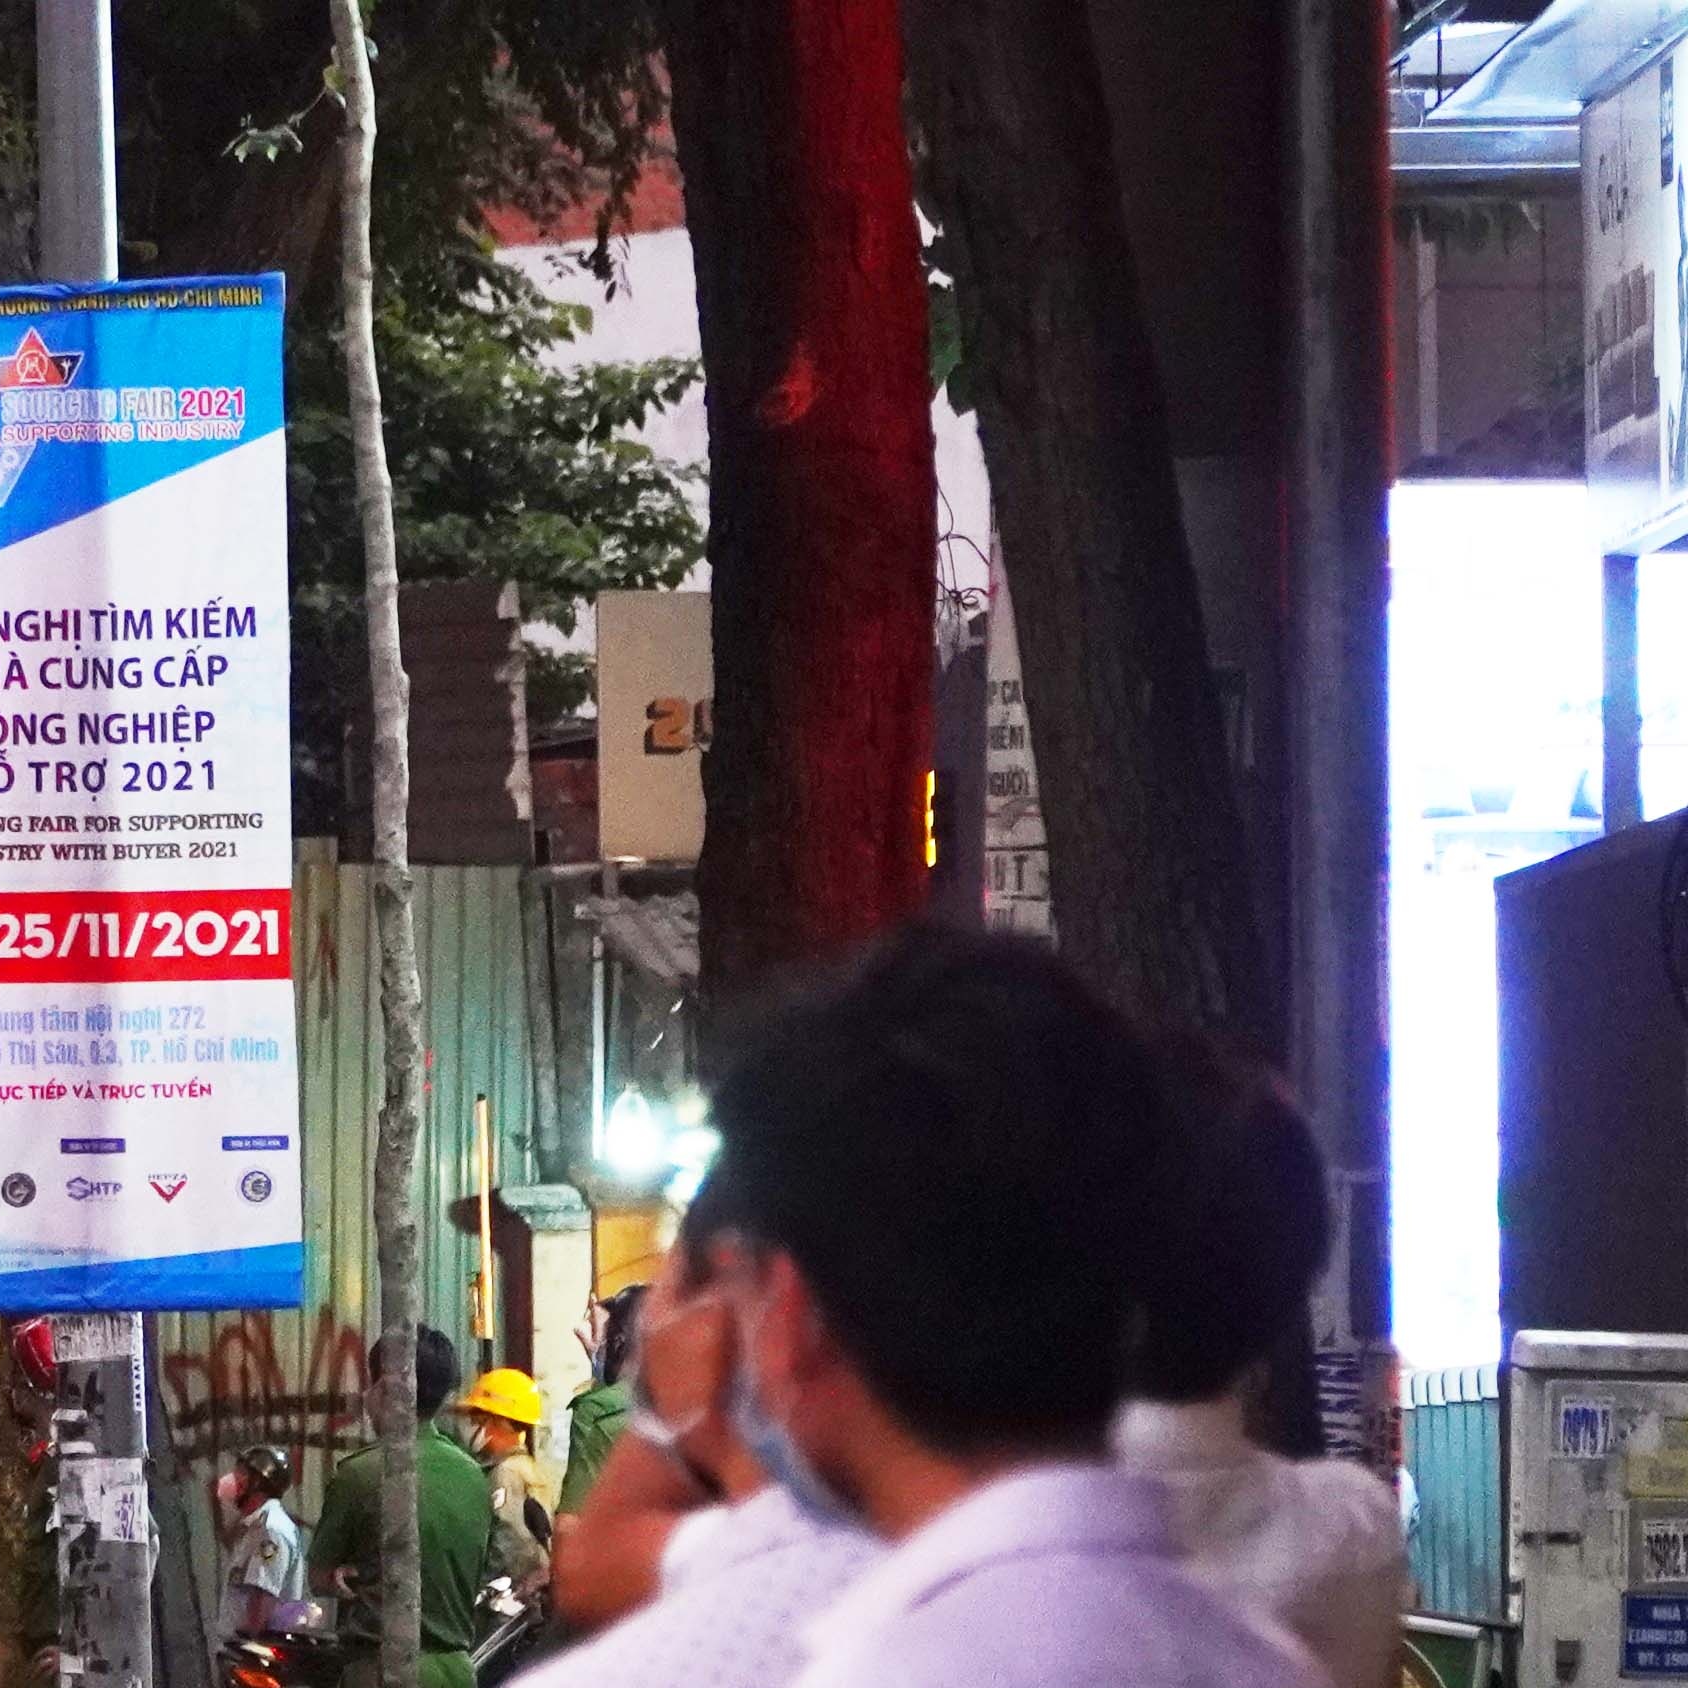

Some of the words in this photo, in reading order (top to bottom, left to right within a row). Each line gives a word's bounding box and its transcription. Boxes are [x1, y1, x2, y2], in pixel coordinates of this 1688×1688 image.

[219, 287, 263, 307] MINH
[122, 388, 175, 419] FAIR
[180, 388, 245, 418] 2021
[2, 423, 133, 442] SUPPORTING
[138, 421, 244, 441] INDUSTRY
[89, 602, 154, 642] TÌM
[166, 597, 258, 639] KIẾM
[39, 657, 143, 689] CUNG
[153, 646, 229, 688] CẤP
[79, 705, 216, 752] NGHIỆP
[28, 759, 107, 802] TRỢ
[123, 760, 215, 792] 2021
[28, 816, 78, 833] FAIR
[85, 815, 121, 833] FOR
[128, 813, 264, 833] SUPPORTING
[52, 843, 107, 862] WITH
[113, 843, 182, 861] BUYER
[189, 841, 238, 859] 2021
[168, 1006, 207, 1030] 272
[130, 1038, 157, 1064] TP.
[230, 1036, 280, 1063] Minh
